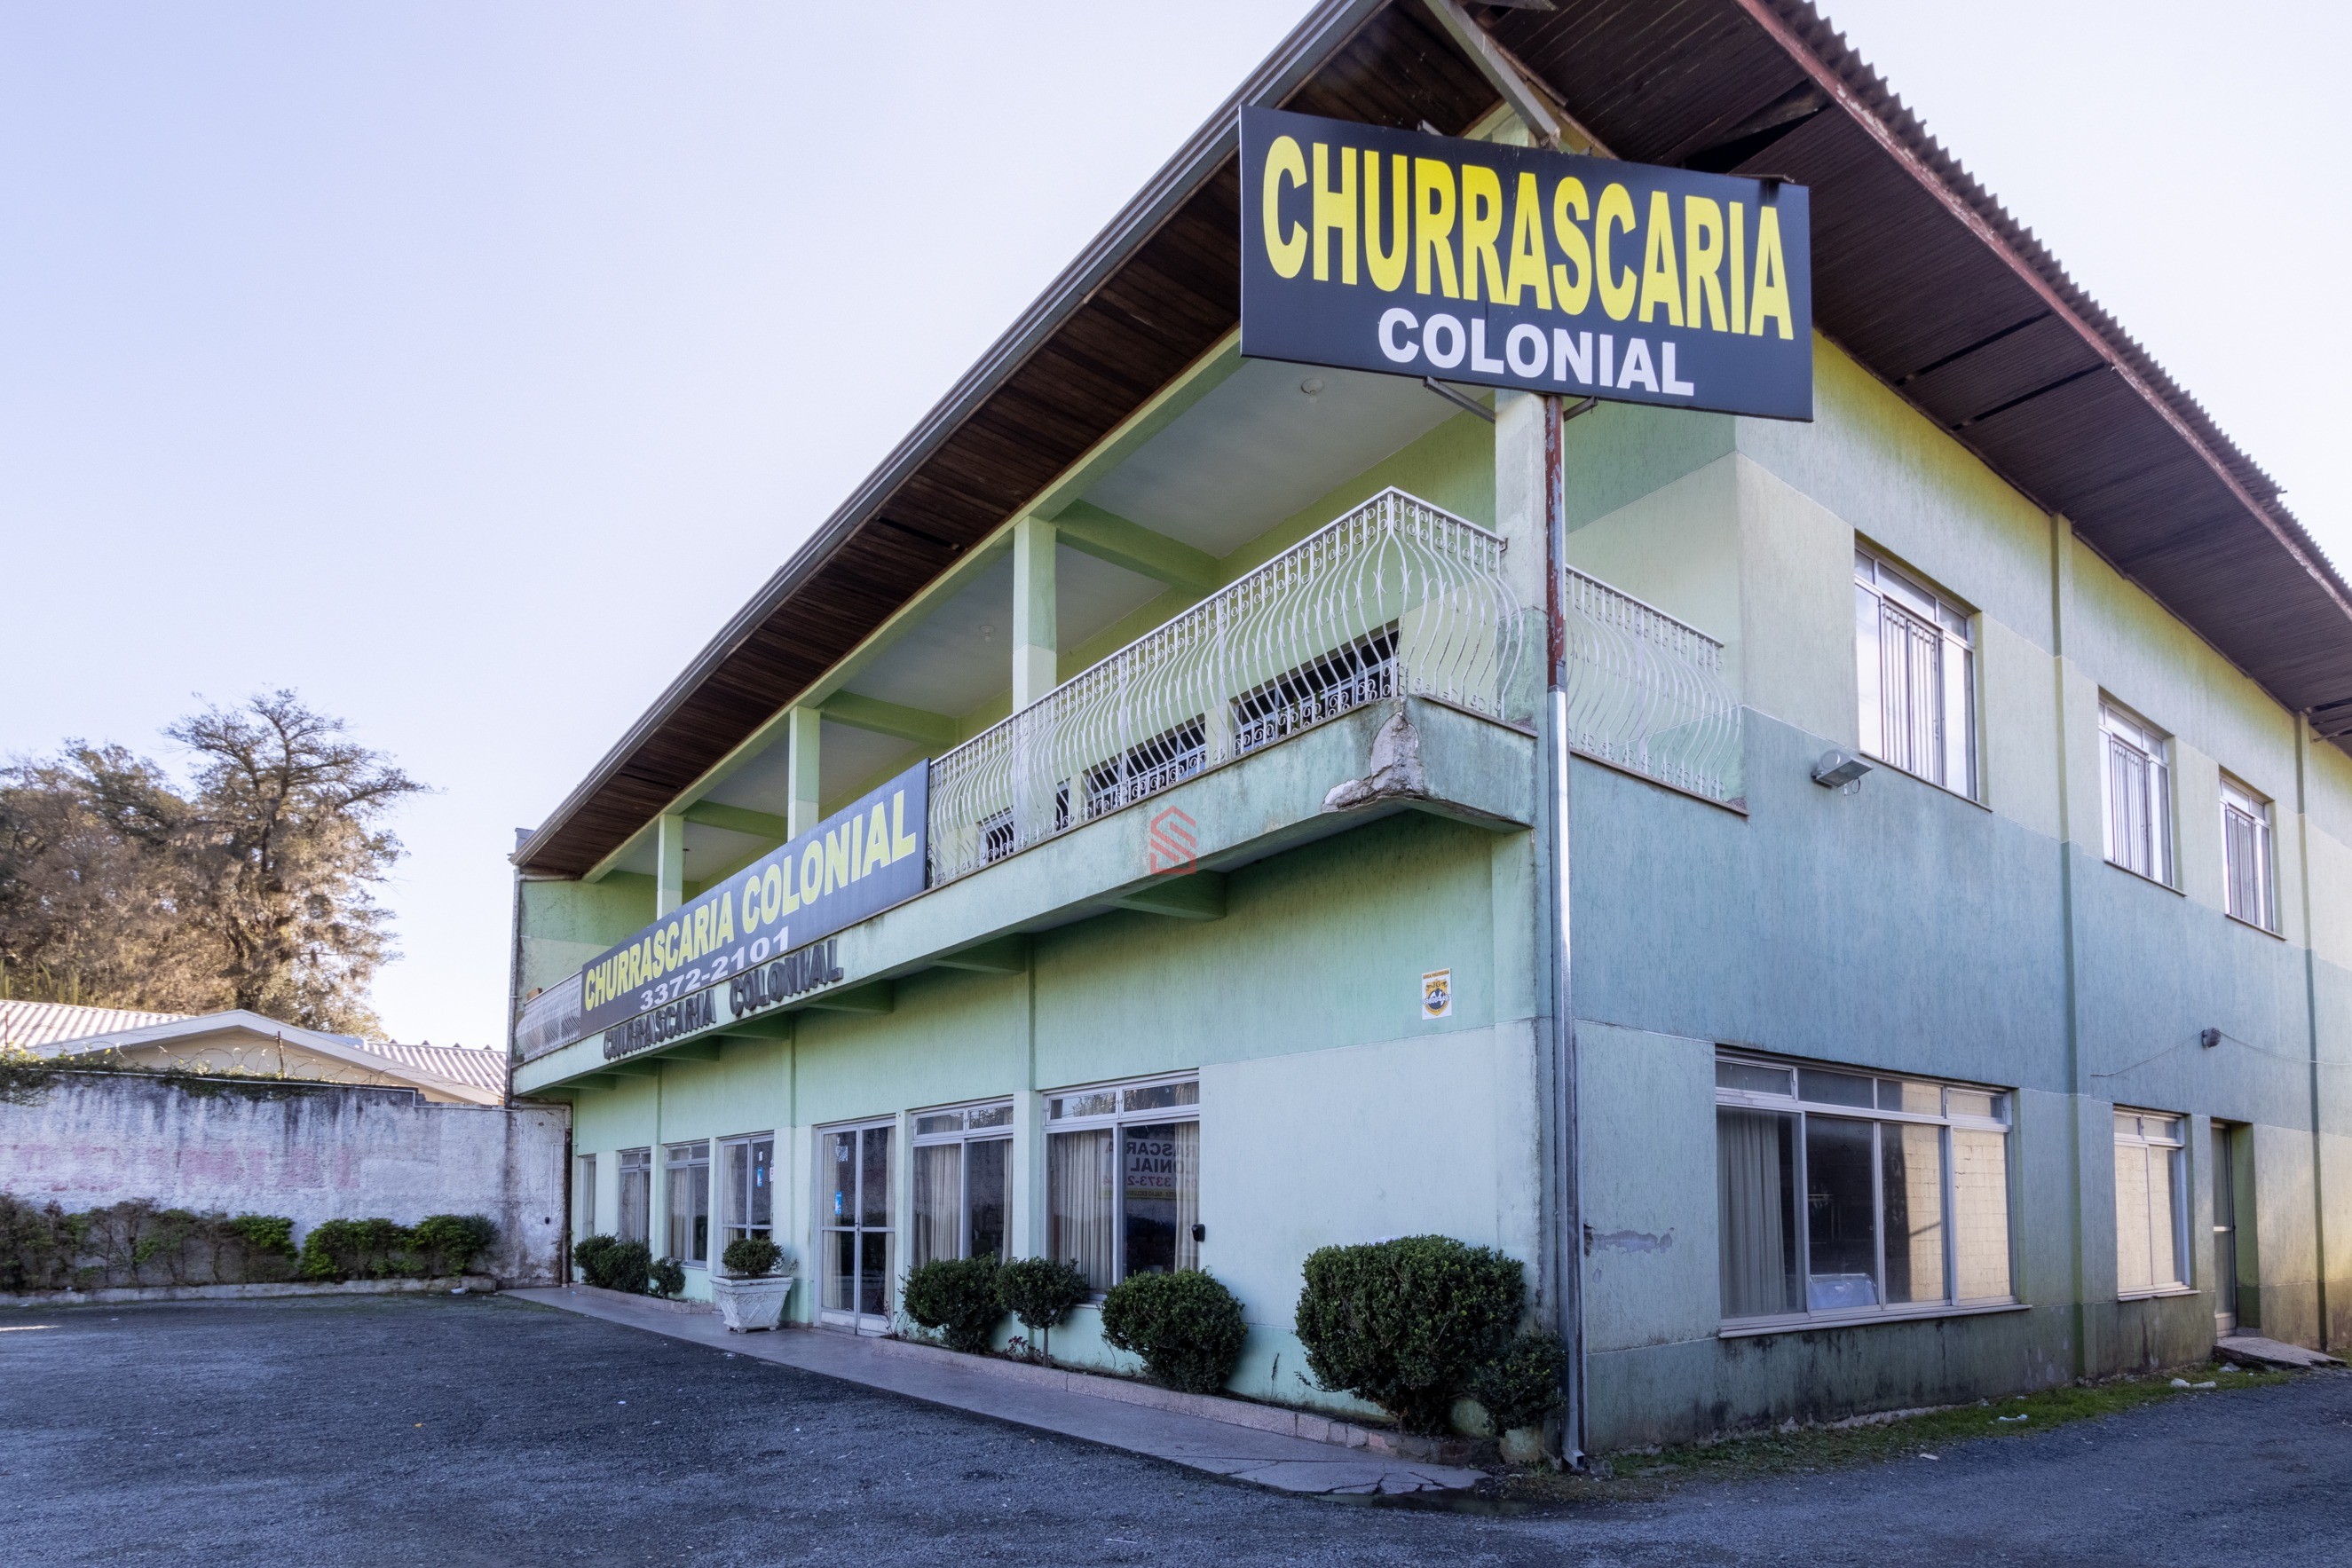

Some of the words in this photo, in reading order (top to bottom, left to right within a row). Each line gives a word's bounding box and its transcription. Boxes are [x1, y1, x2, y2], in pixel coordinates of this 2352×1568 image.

[1262, 135, 1794, 341] CHURRASCARIA
[1377, 307, 1695, 397] COLONIAL
[584, 890, 735, 1011] CHURRASCARIA
[742, 789, 916, 934] COLONIAL
[603, 989, 716, 1060] CHURRASCARIA
[730, 939, 843, 1016] COLONIAL
[640, 926, 789, 1011] 3372-2101
